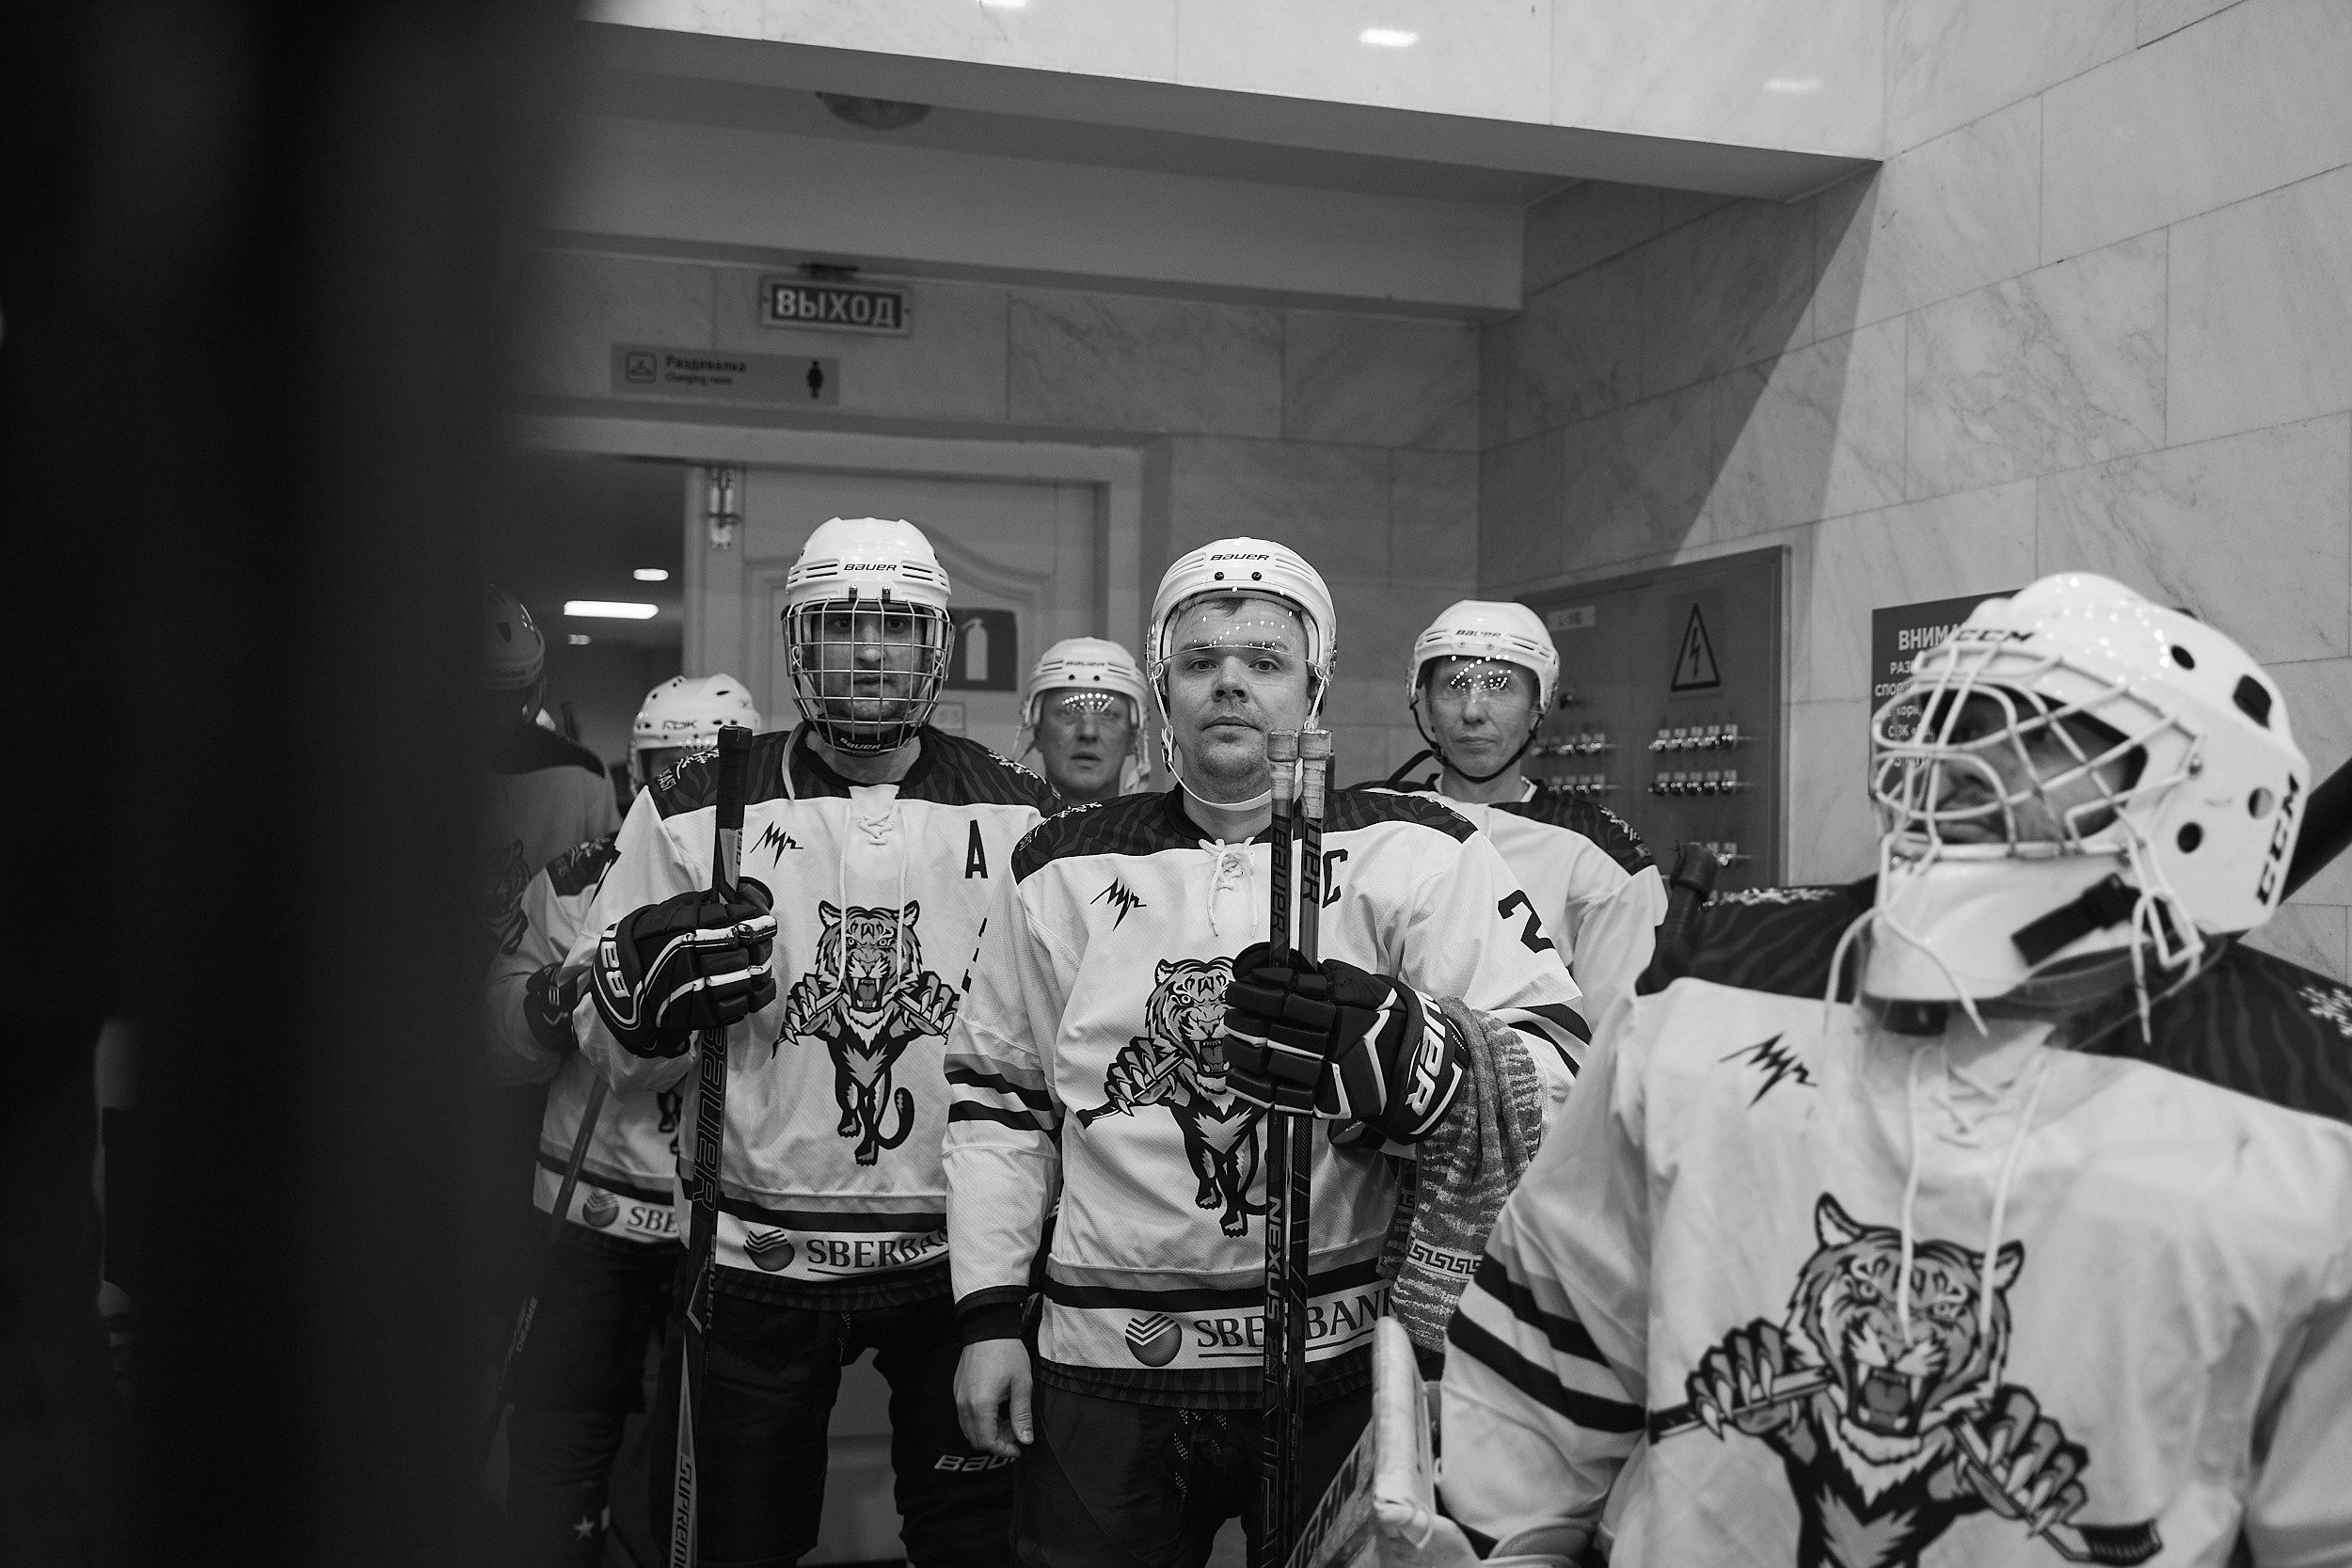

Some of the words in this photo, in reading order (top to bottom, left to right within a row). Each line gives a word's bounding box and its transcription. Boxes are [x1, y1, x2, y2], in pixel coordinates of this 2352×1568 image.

[776, 289, 896, 327] ВЫХОД
[665, 354, 747, 373] Раздевалка
[844, 563, 898, 572] BAUER
[1210, 553, 1270, 562] BAUER
[1956, 628, 2037, 642] CCM
[965, 819, 988, 879] A
[2256, 769, 2299, 907] CCM
[1271, 827, 1288, 934] BAUER
[692, 1024, 727, 1212] BAUER
[1267, 1195, 1282, 1321] NEXUS
